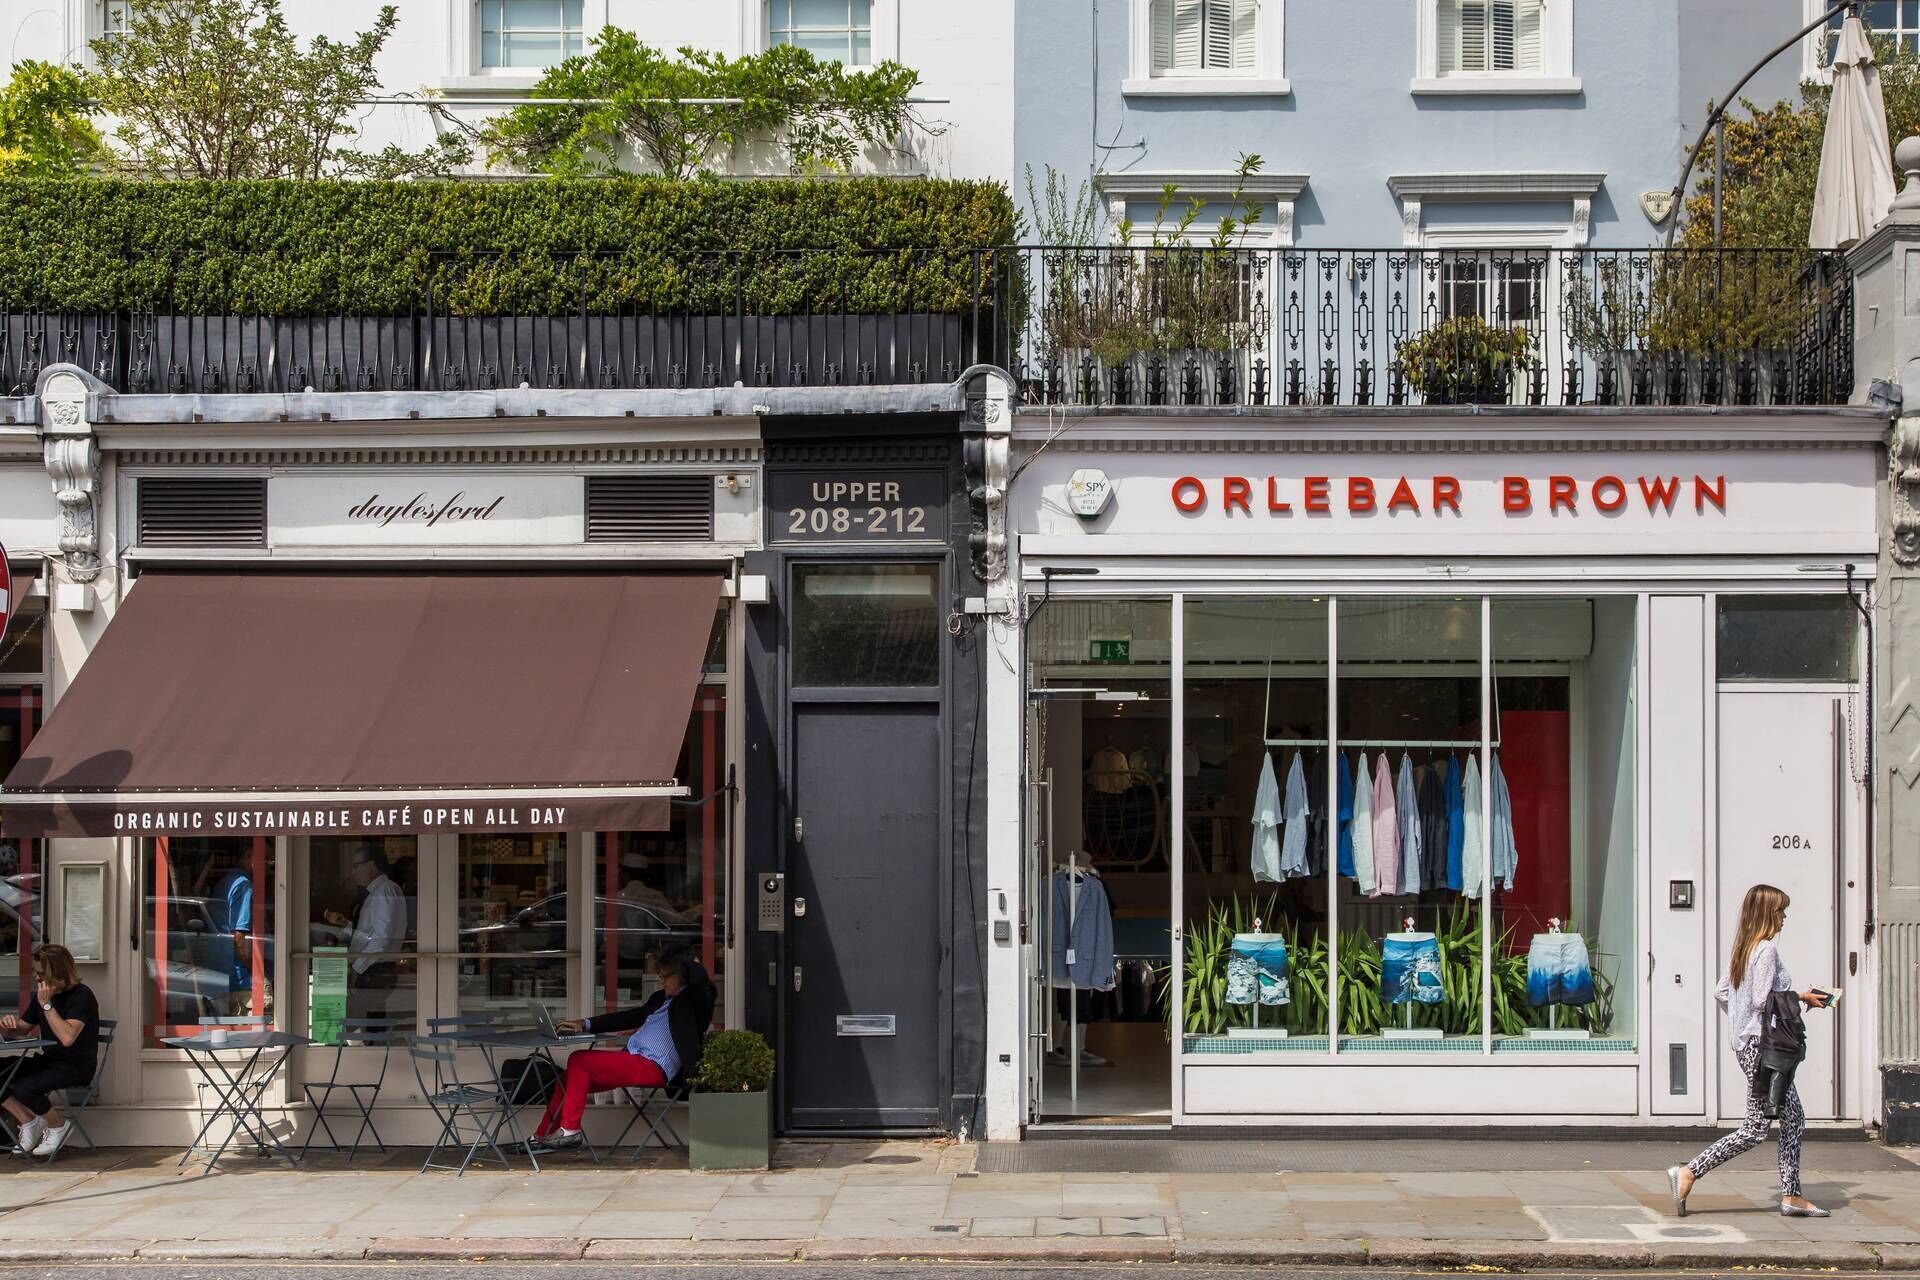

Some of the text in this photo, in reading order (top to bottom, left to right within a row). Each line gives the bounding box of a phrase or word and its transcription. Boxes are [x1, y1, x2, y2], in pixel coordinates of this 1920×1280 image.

[812, 482, 901, 502] UPPER
[1085, 481, 1106, 492] SPY
[1171, 474, 1725, 512] ORLEBAR BROWN
[348, 491, 505, 529] daylesford
[788, 506, 926, 534] 208-212
[114, 805, 566, 830] ORGANIC SUSTAINABLE CAFÉ OPEN ALL DAY
